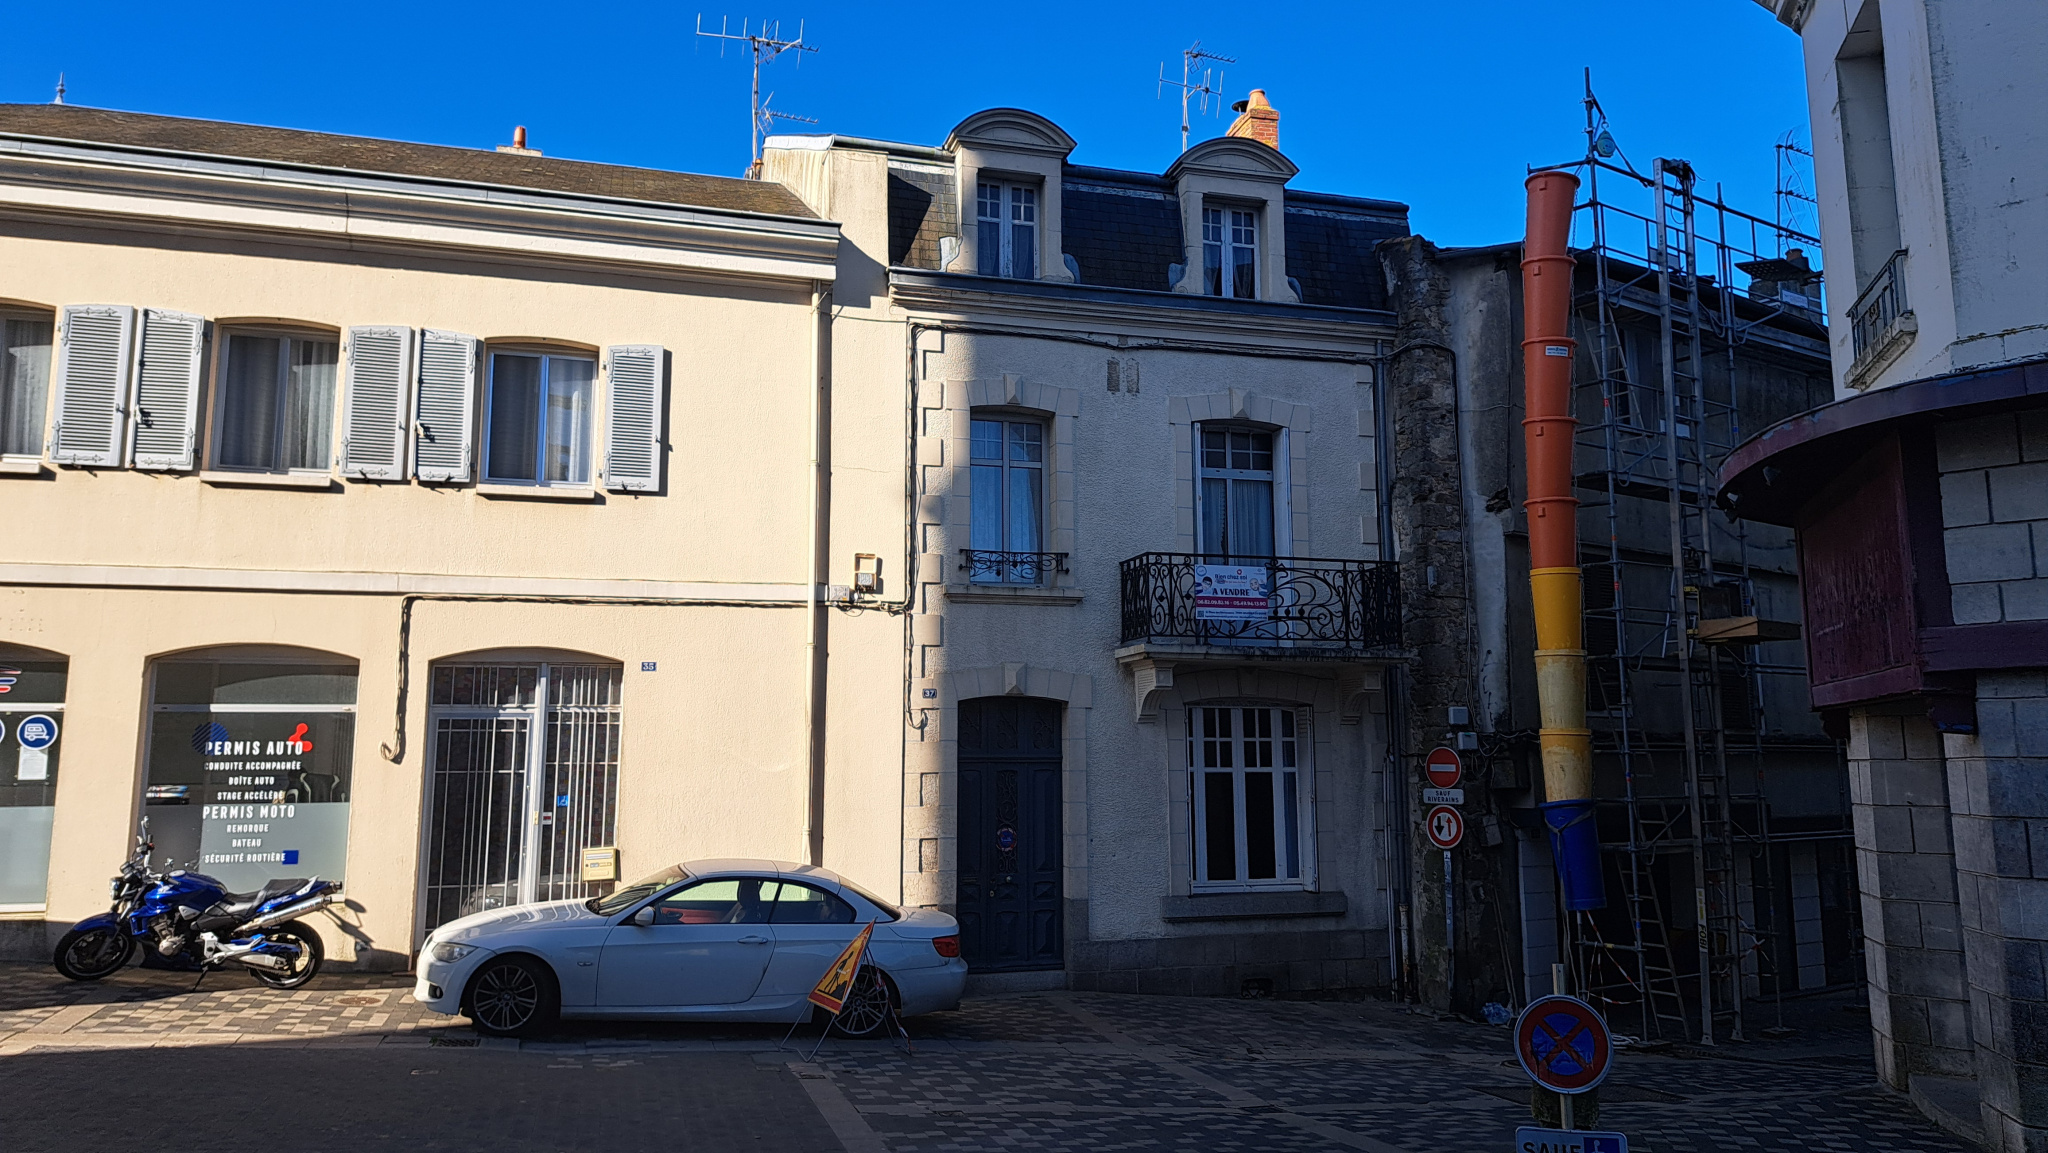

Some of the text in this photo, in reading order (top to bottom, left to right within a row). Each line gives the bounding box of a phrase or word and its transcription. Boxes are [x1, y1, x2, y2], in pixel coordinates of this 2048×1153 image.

[1220, 588, 1250, 596] VENDRE
[205, 741, 303, 755] PERMIS AUTO
[204, 760, 301, 770] CONDUITE ACCOMPAGNÉE
[229, 776, 274, 785] BOÎTE AUTO
[217, 790, 283, 800] STAGE ACCÉLÉRÉ
[203, 805, 295, 819] PERMIS MOTO
[227, 824, 269, 833] REMORQUE
[232, 839, 262, 847] BATEAU
[205, 853, 286, 863] SÉCURITÉ ROUTIÈRE
